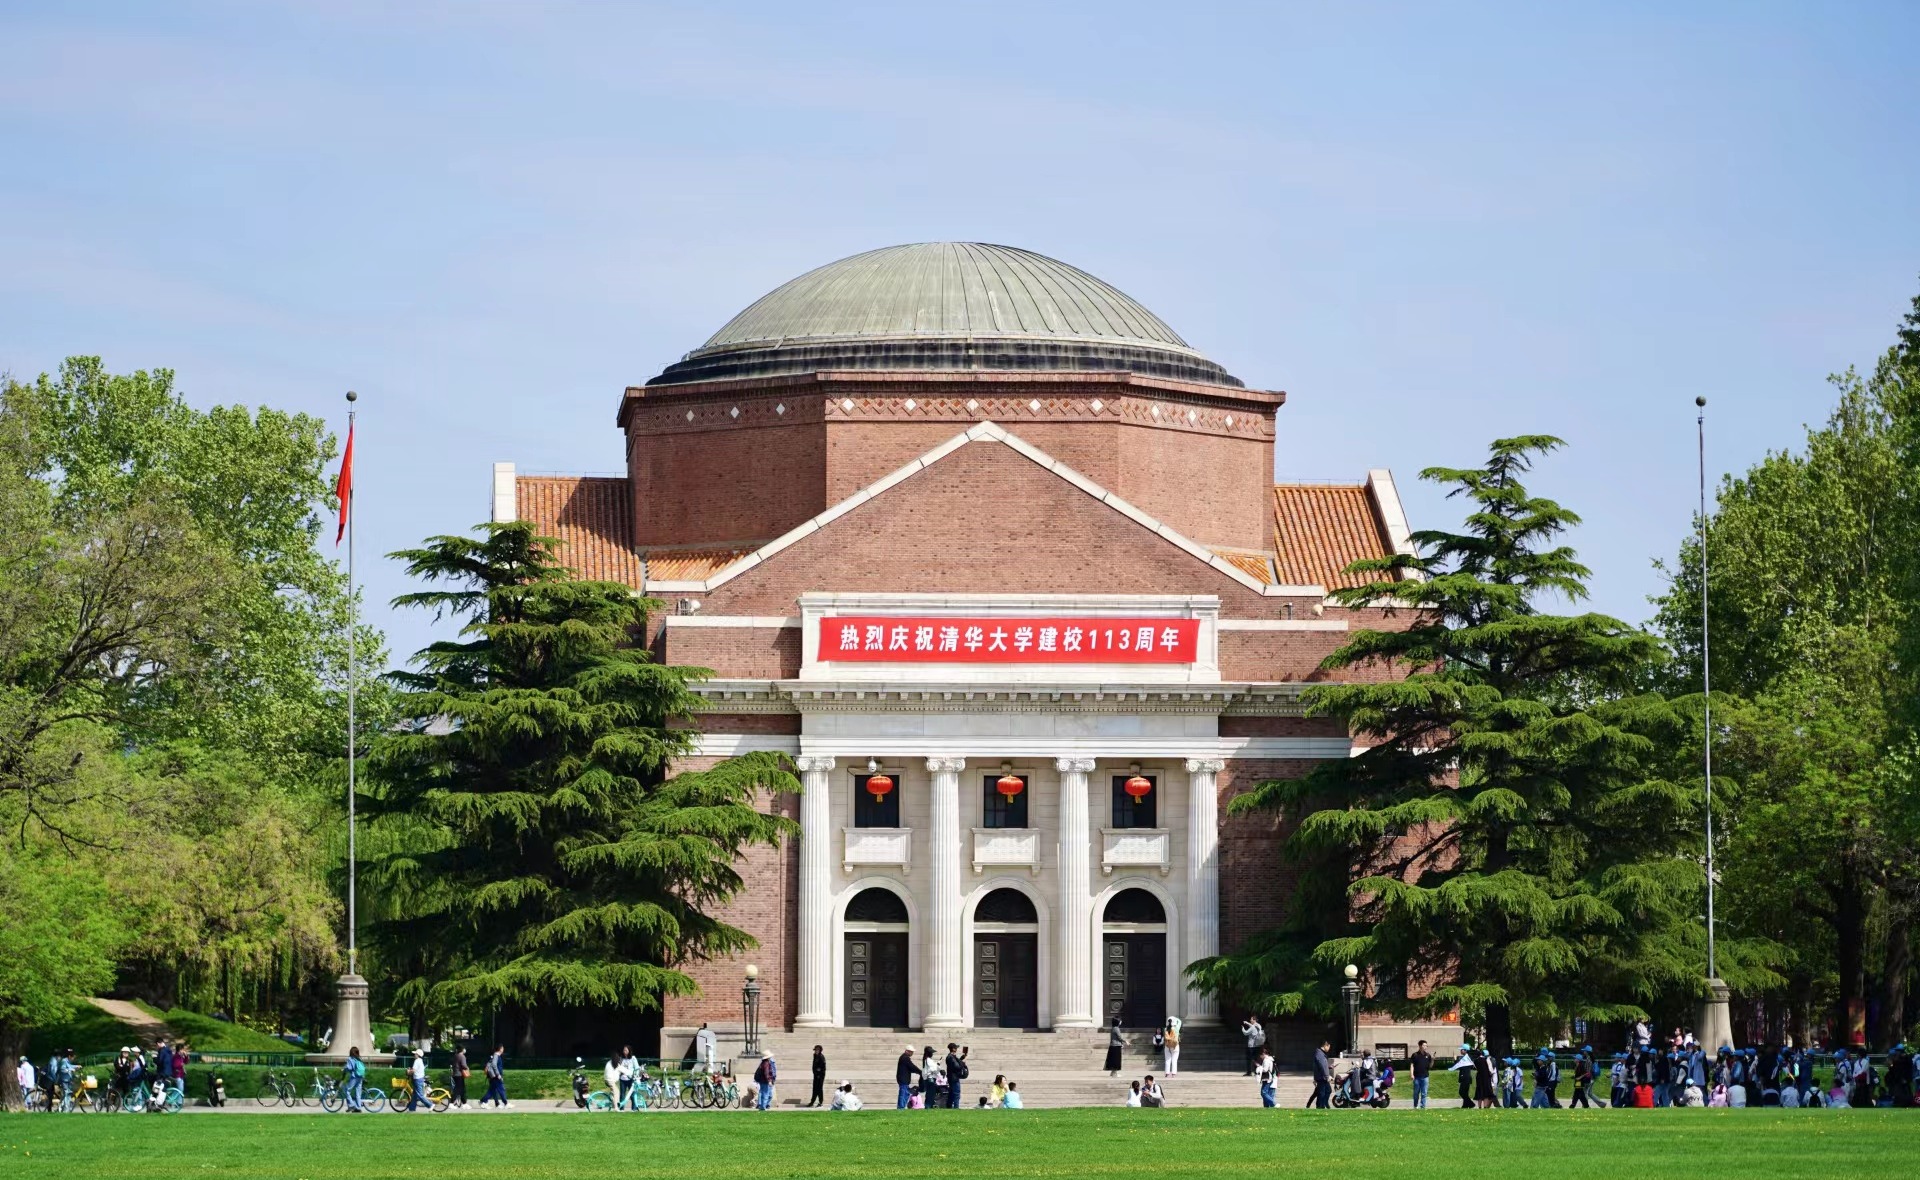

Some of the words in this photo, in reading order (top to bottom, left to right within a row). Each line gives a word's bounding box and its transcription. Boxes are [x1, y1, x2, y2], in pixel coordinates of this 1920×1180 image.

[840, 624, 1180, 653] 热烈庆祝清华大学建校113周年
